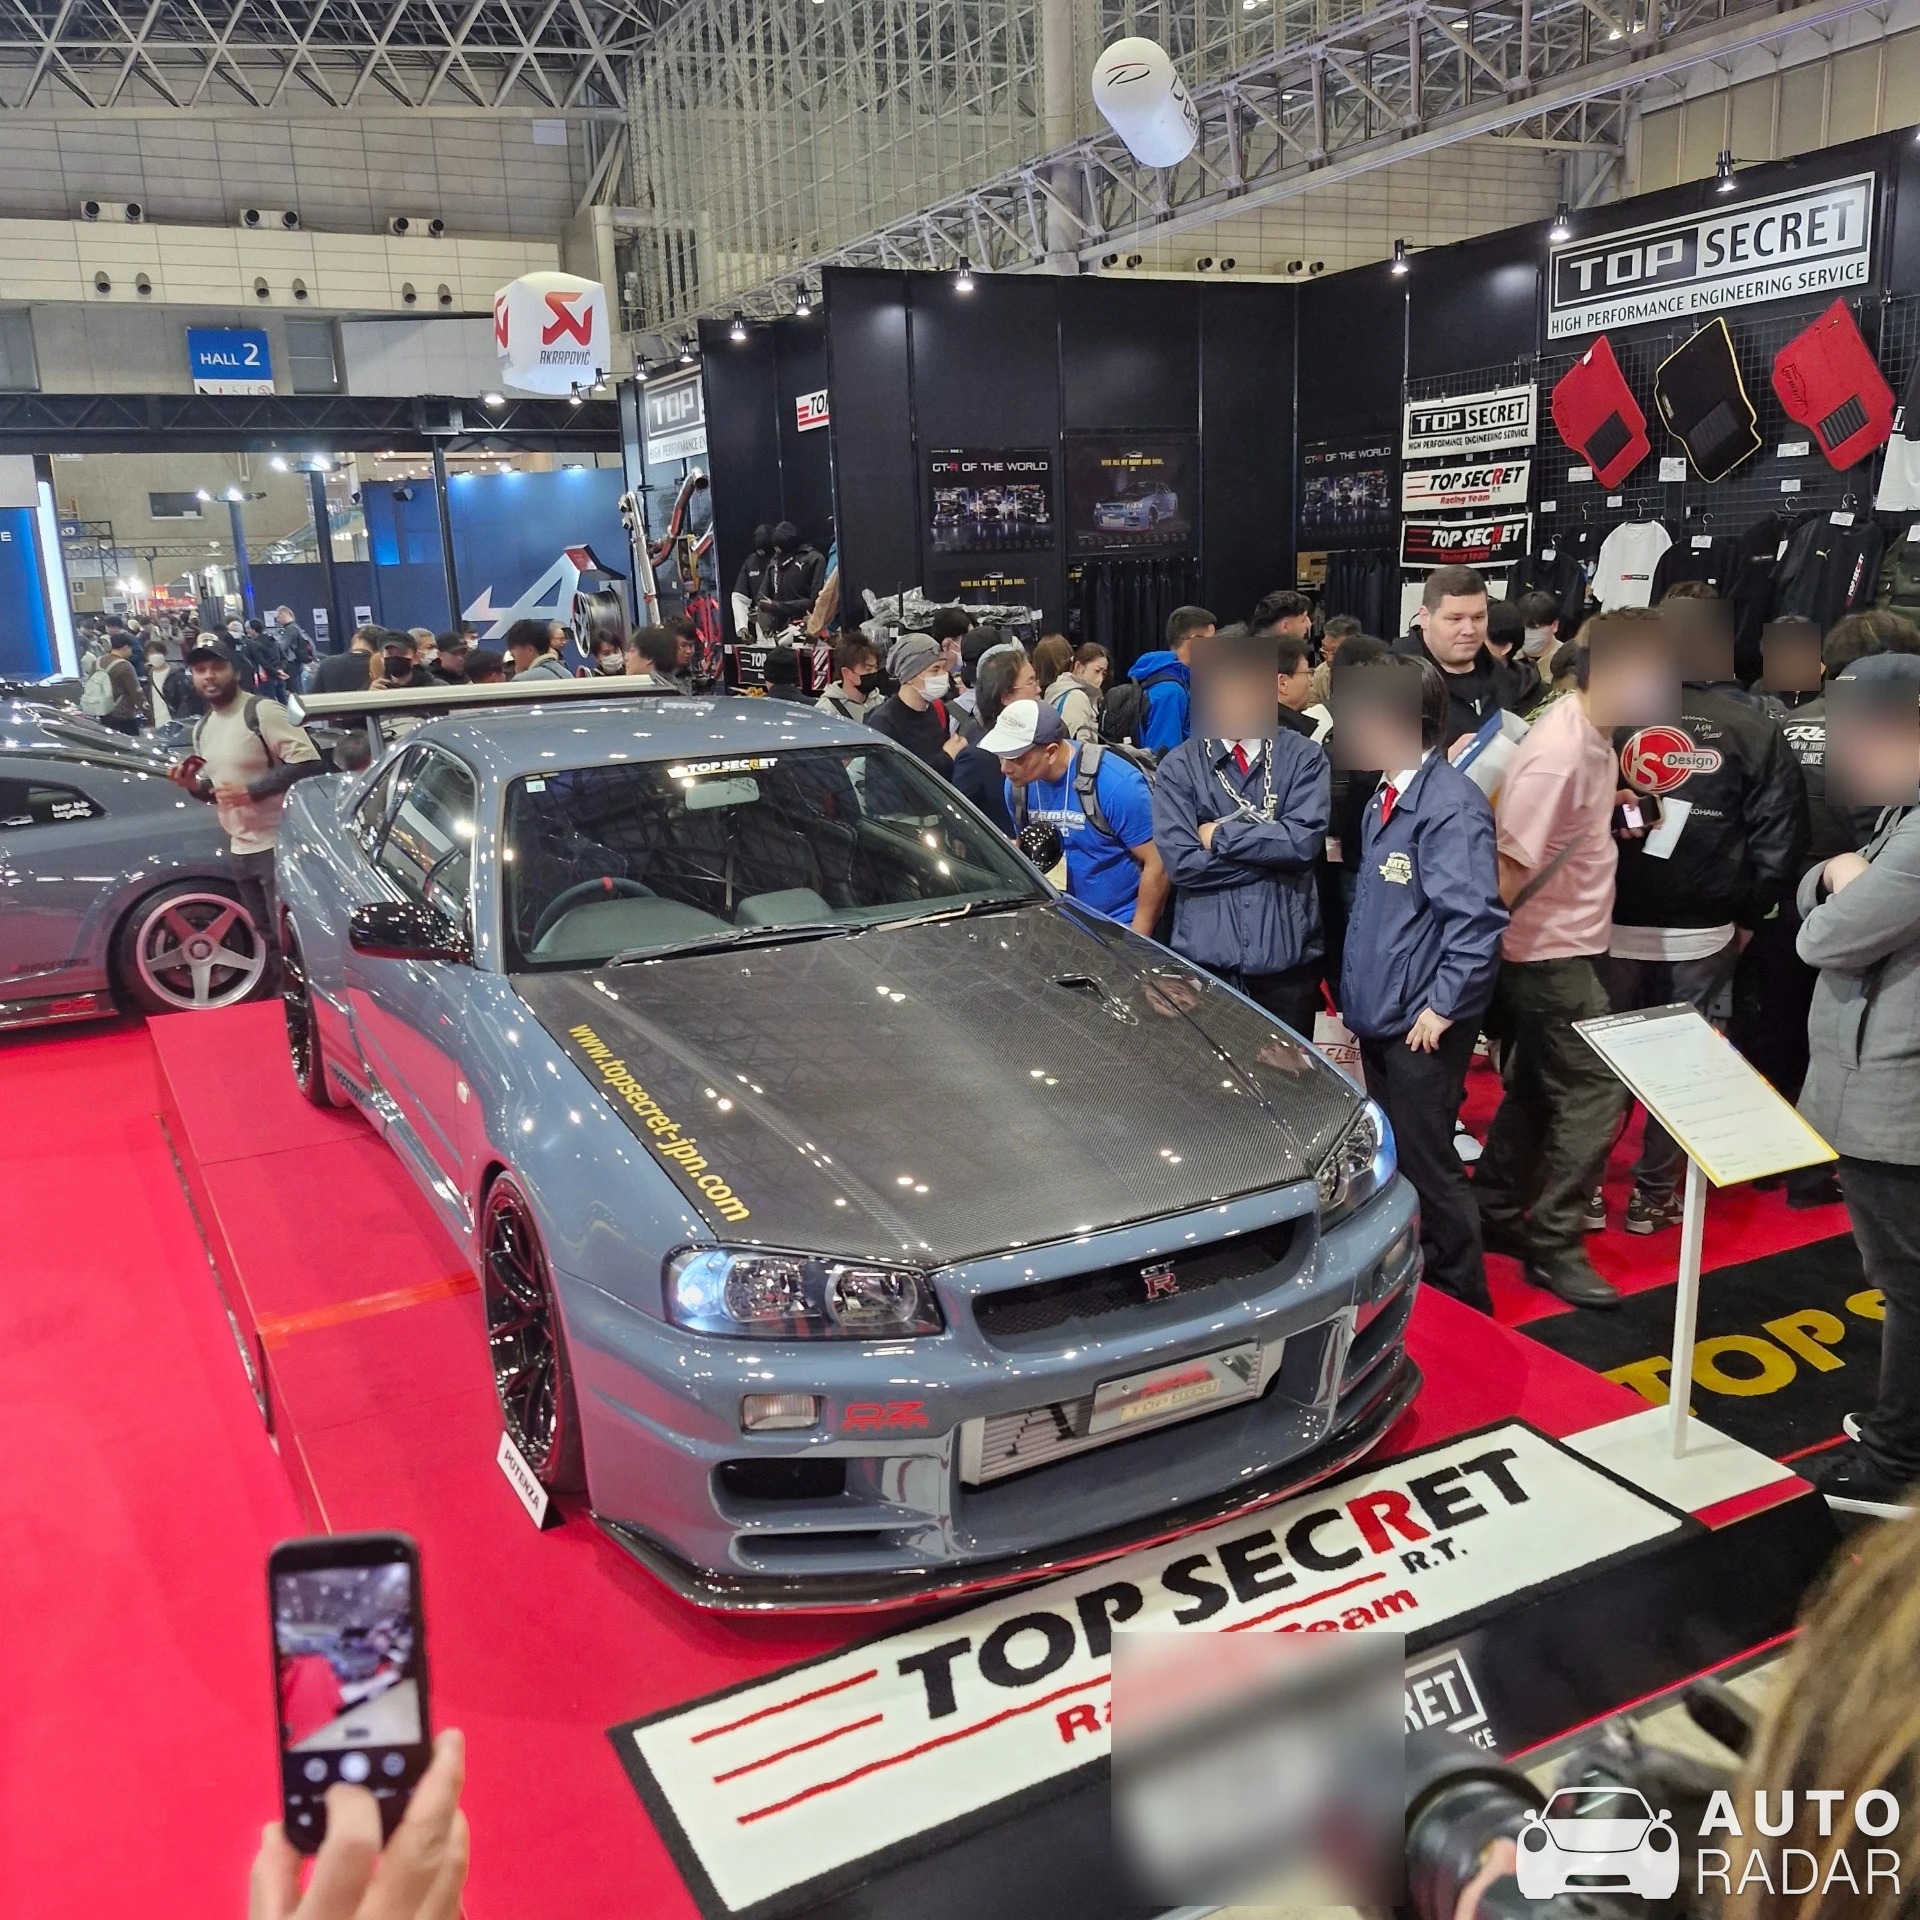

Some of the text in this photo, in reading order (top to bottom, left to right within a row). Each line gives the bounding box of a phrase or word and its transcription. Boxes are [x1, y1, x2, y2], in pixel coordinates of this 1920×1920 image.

[1570, 199, 1855, 292] TOP SECRET
[1551, 261, 1865, 334] HIGH PERFORMANCE ENGINEERING SERVICE
[201, 342, 261, 366] HALL 2
[540, 350, 590, 366] AKRAPOVIČ
[651, 387, 695, 426] TOP
[1416, 411, 1461, 432] TOP
[1468, 401, 1524, 427] SECRET
[1407, 427, 1529, 450] HIGH PERFORMANCE ENGINEERING SERVICE
[932, 461, 1049, 473] GT-R OF THE WORLD
[1325, 453, 1337, 463] OF
[1339, 450, 1356, 460] THE
[1358, 446, 1391, 458] WORLD
[1429, 466, 1525, 491] TOP SECRET
[1439, 494, 1491, 505] Racing Team
[1431, 523, 1525, 548] TOP SECRET
[750, 652, 767, 667] TOP
[687, 757, 778, 774] TOP SECRET
[1667, 753, 1713, 768] Design
[1801, 752, 1824, 765] SINCE
[569, 1024, 750, 1222] www.topsecret-jpn.com
[1146, 1272, 1180, 1299] R
[504, 1449, 541, 1510] POTENZA
[1400, 1538, 1469, 1576] R.T.
[897, 1448, 1533, 1721] TOP SECRET
